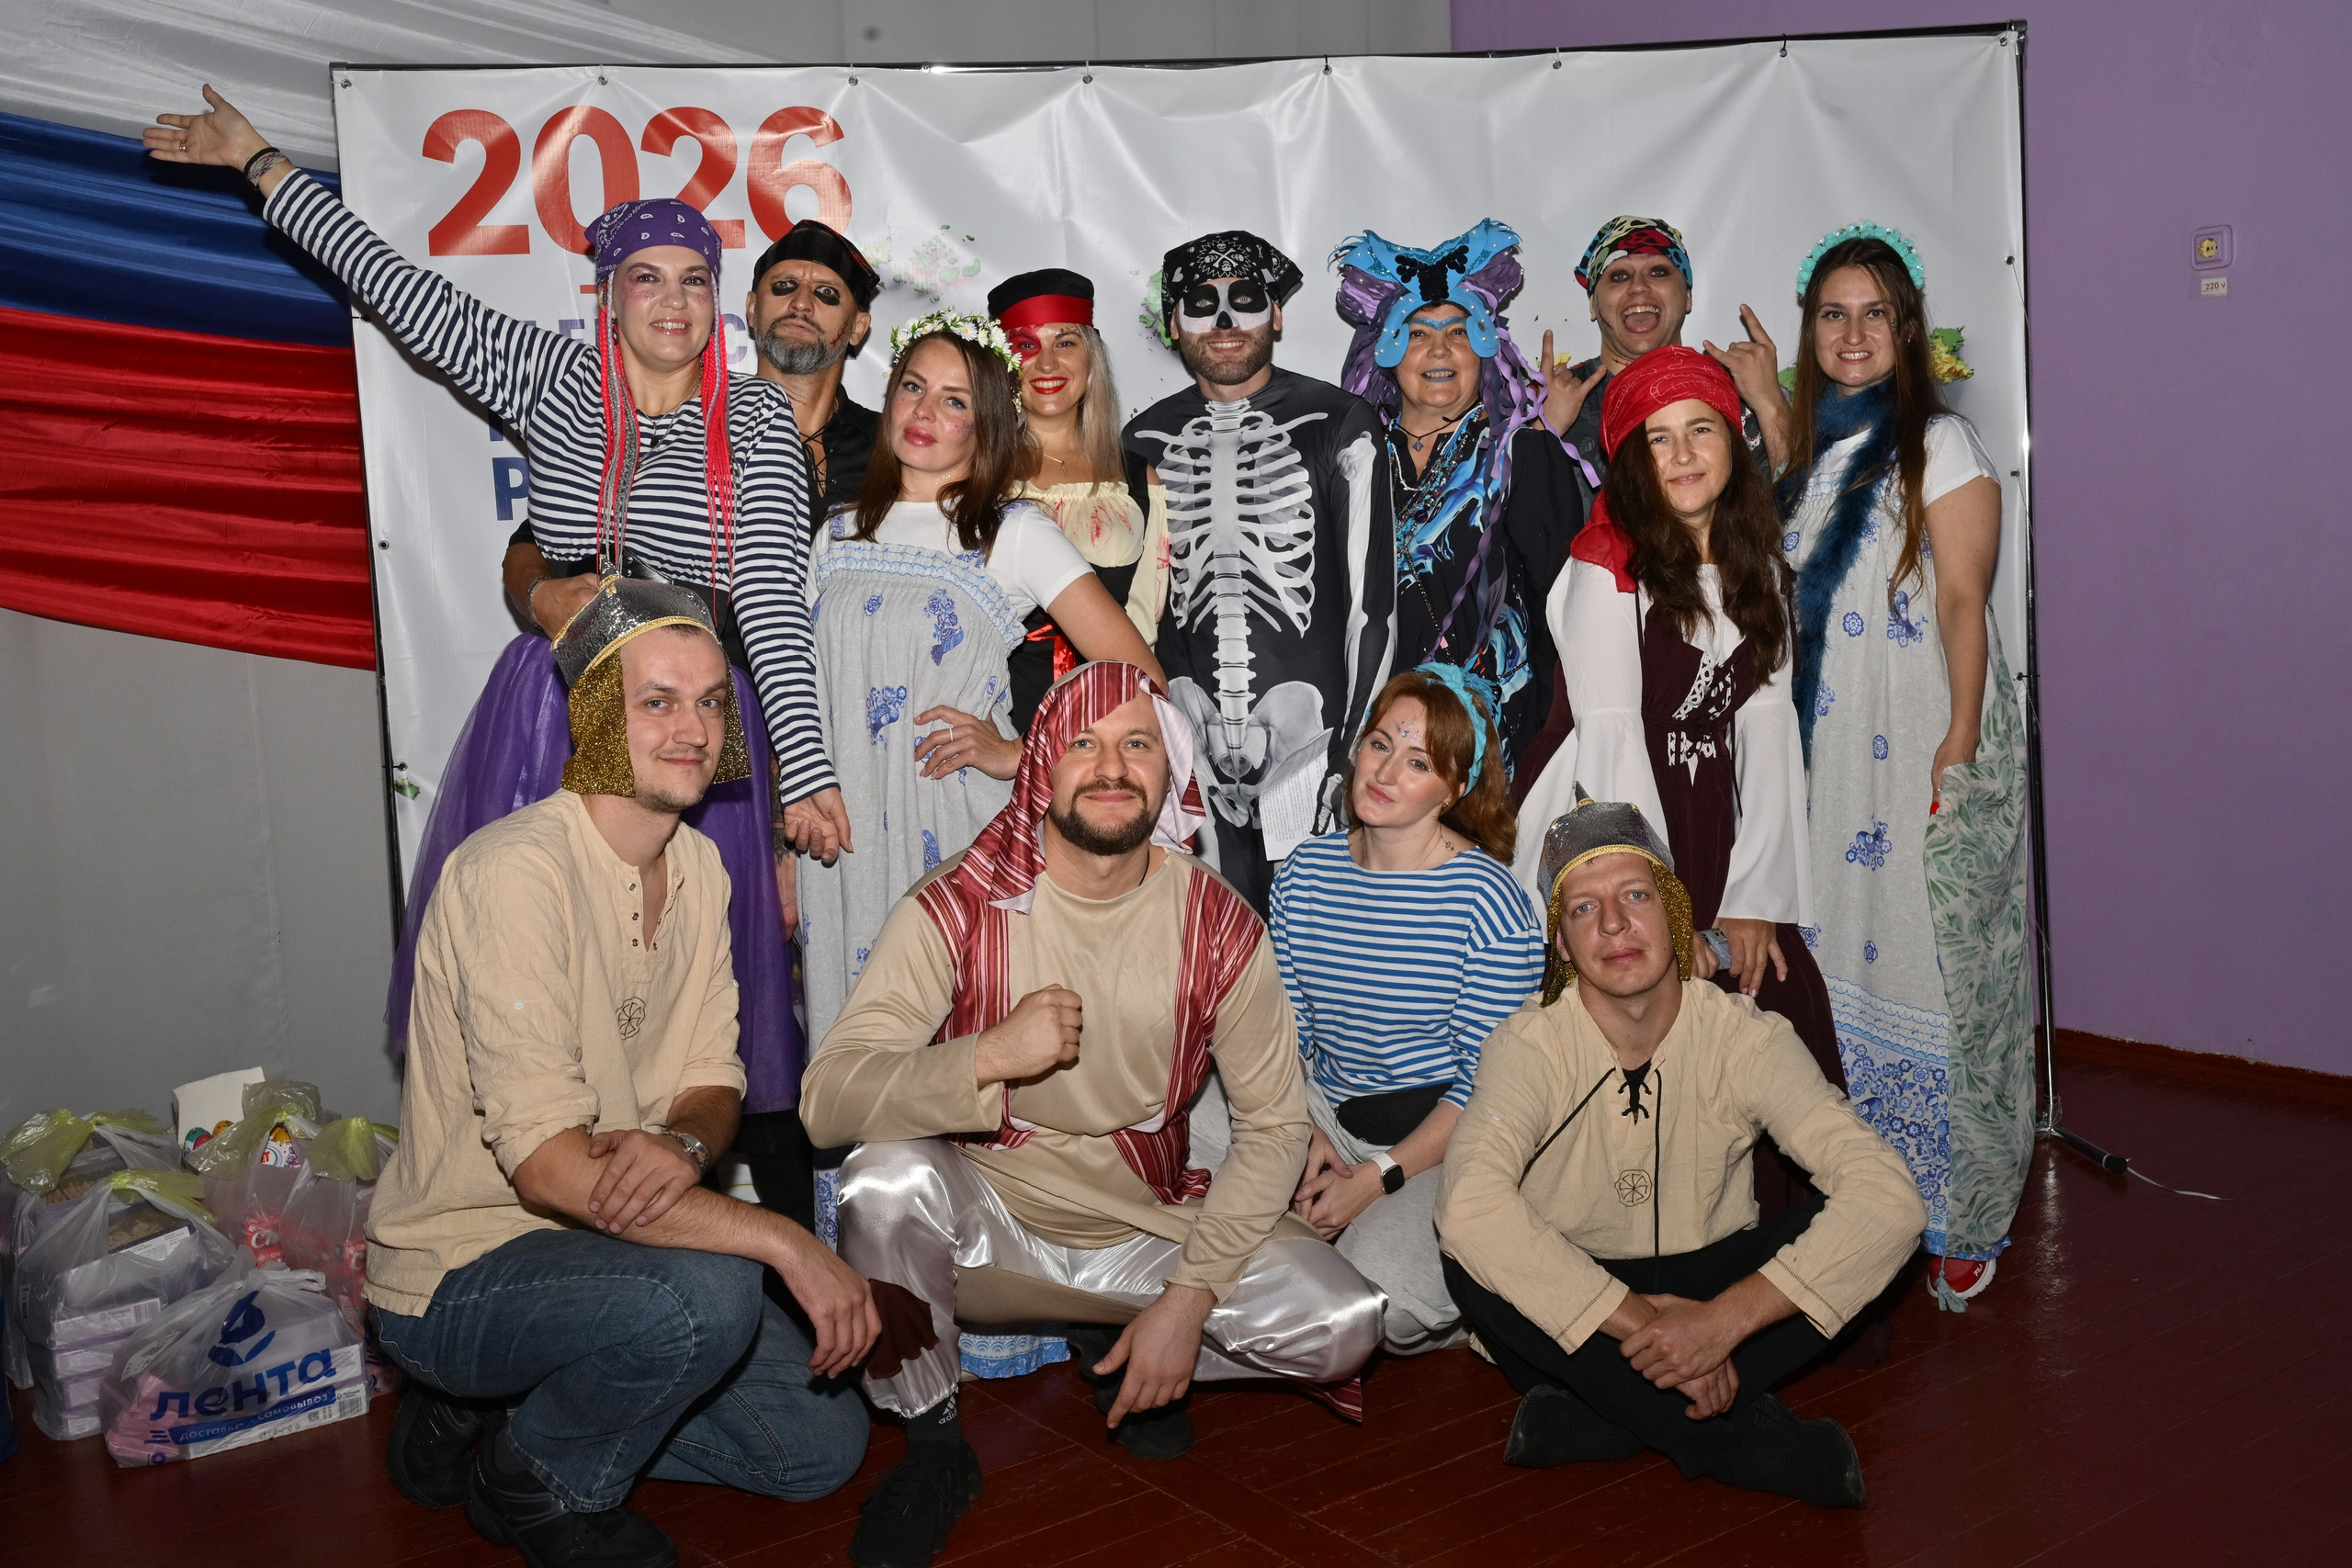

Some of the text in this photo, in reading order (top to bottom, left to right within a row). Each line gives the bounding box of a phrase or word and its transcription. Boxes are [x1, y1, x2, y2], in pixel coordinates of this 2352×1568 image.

[422, 106, 853, 257] 2026
[2205, 282, 2219, 290] 220
[150, 1348, 337, 1421] лента
[938, 1406, 957, 1425] adid
